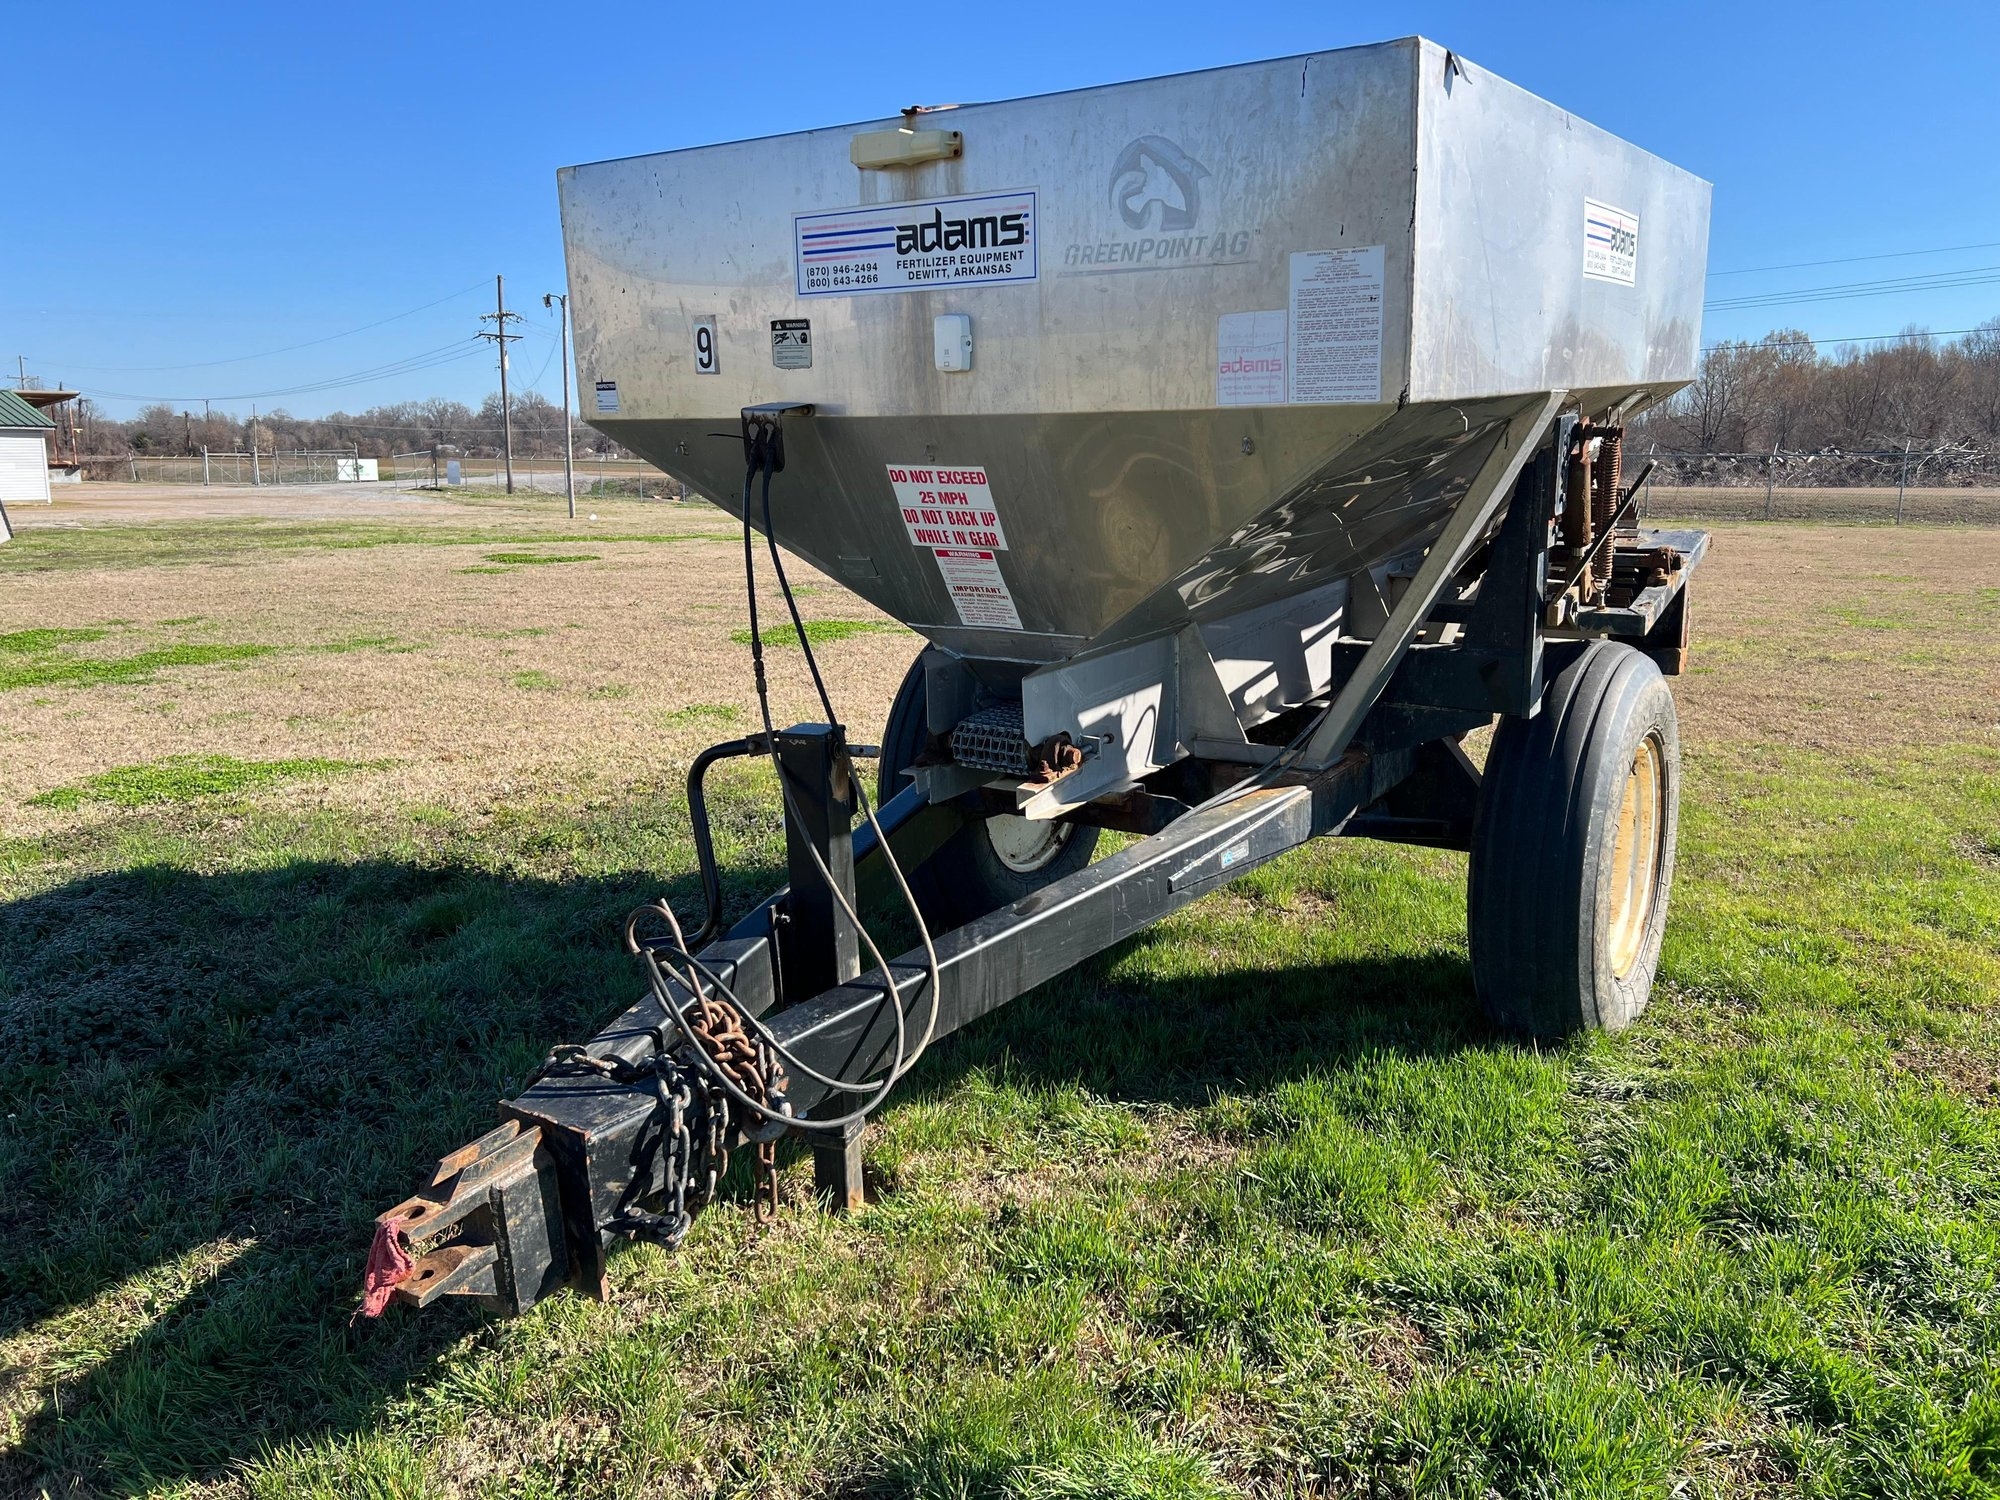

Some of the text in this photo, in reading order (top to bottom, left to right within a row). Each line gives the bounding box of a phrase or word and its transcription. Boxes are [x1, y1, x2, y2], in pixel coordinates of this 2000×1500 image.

[896, 207, 1024, 255] adams
[1611, 218, 1636, 257] adams
[1208, 230, 1250, 258] AG
[896, 250, 1024, 270] FERTILIZER EQUIPMENT
[806, 262, 878, 278] (870) 946-2494
[908, 264, 1012, 281] DEWITT, ARKANSAS
[807, 274, 878, 289] (800) 643-4266
[697, 327, 713, 369] 9
[1220, 356, 1282, 374] adams
[889, 470, 986, 485] DO NOT EXCEED
[919, 491, 968, 505] 25 MPH
[903, 509, 996, 527] DO NOT BACK UP
[914, 529, 999, 546] WHILE IN GEAR
[952, 585, 1001, 594] IMPORTANT
